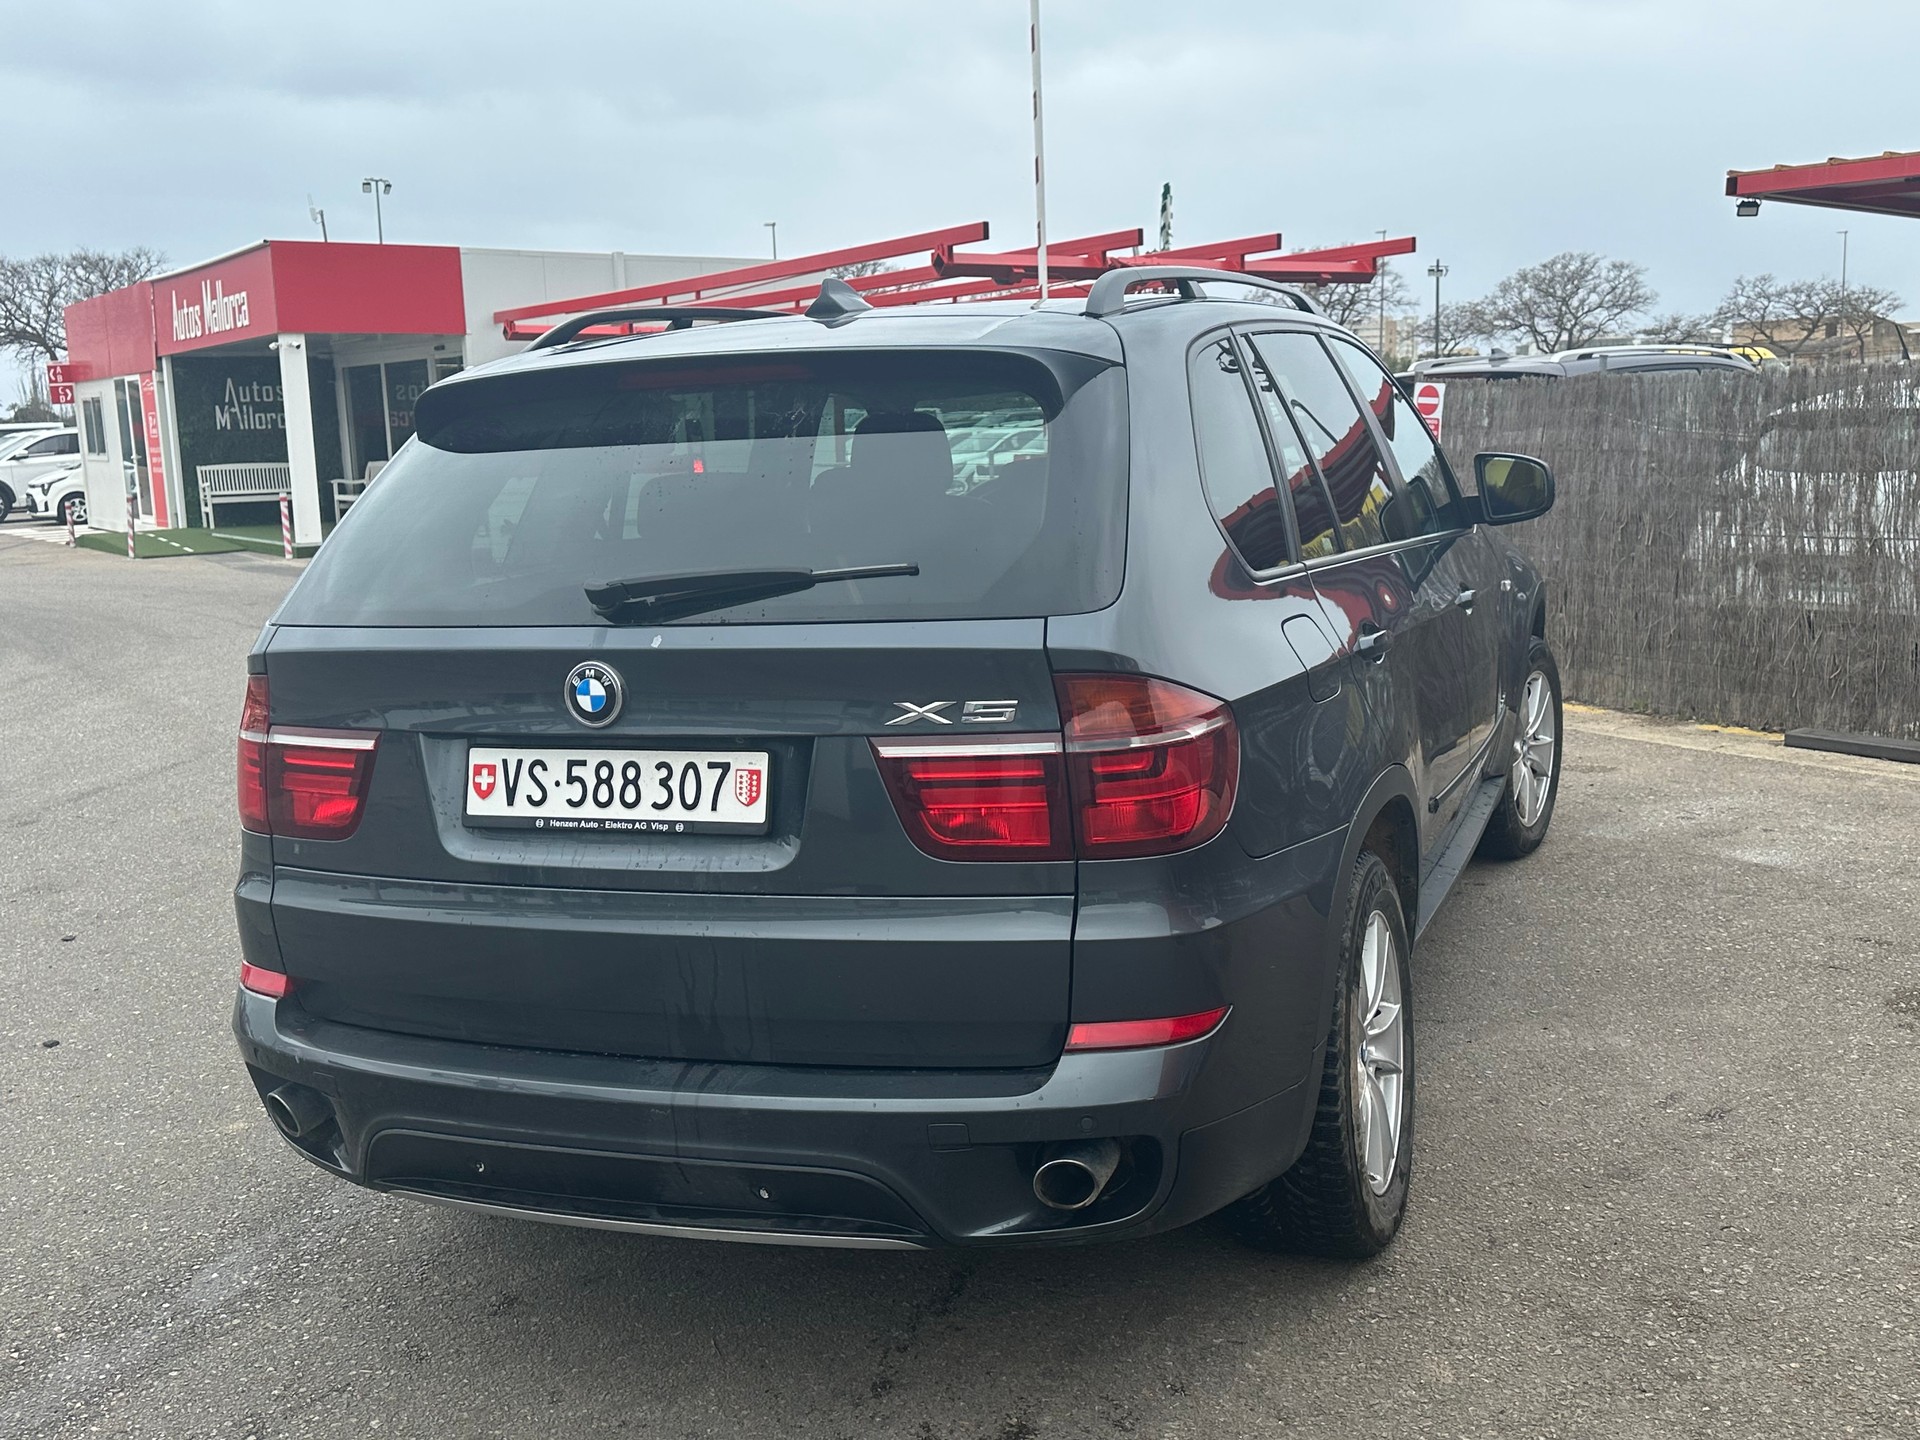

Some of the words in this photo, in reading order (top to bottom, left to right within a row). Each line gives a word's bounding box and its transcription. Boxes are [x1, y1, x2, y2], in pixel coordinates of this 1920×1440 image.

[172, 289, 202, 342] Autos
[201, 279, 250, 335] Mallorca
[56, 366, 62, 374] A
[224, 377, 284, 403] Autos
[572, 669, 612, 687] BMW
[884, 699, 1019, 726] X5
[549, 819, 579, 829] Henzen
[579, 819, 599, 829] Auto
[605, 820, 633, 830] Elektro
[633, 821, 647, 830] AG
[650, 822, 669, 832] Visp
